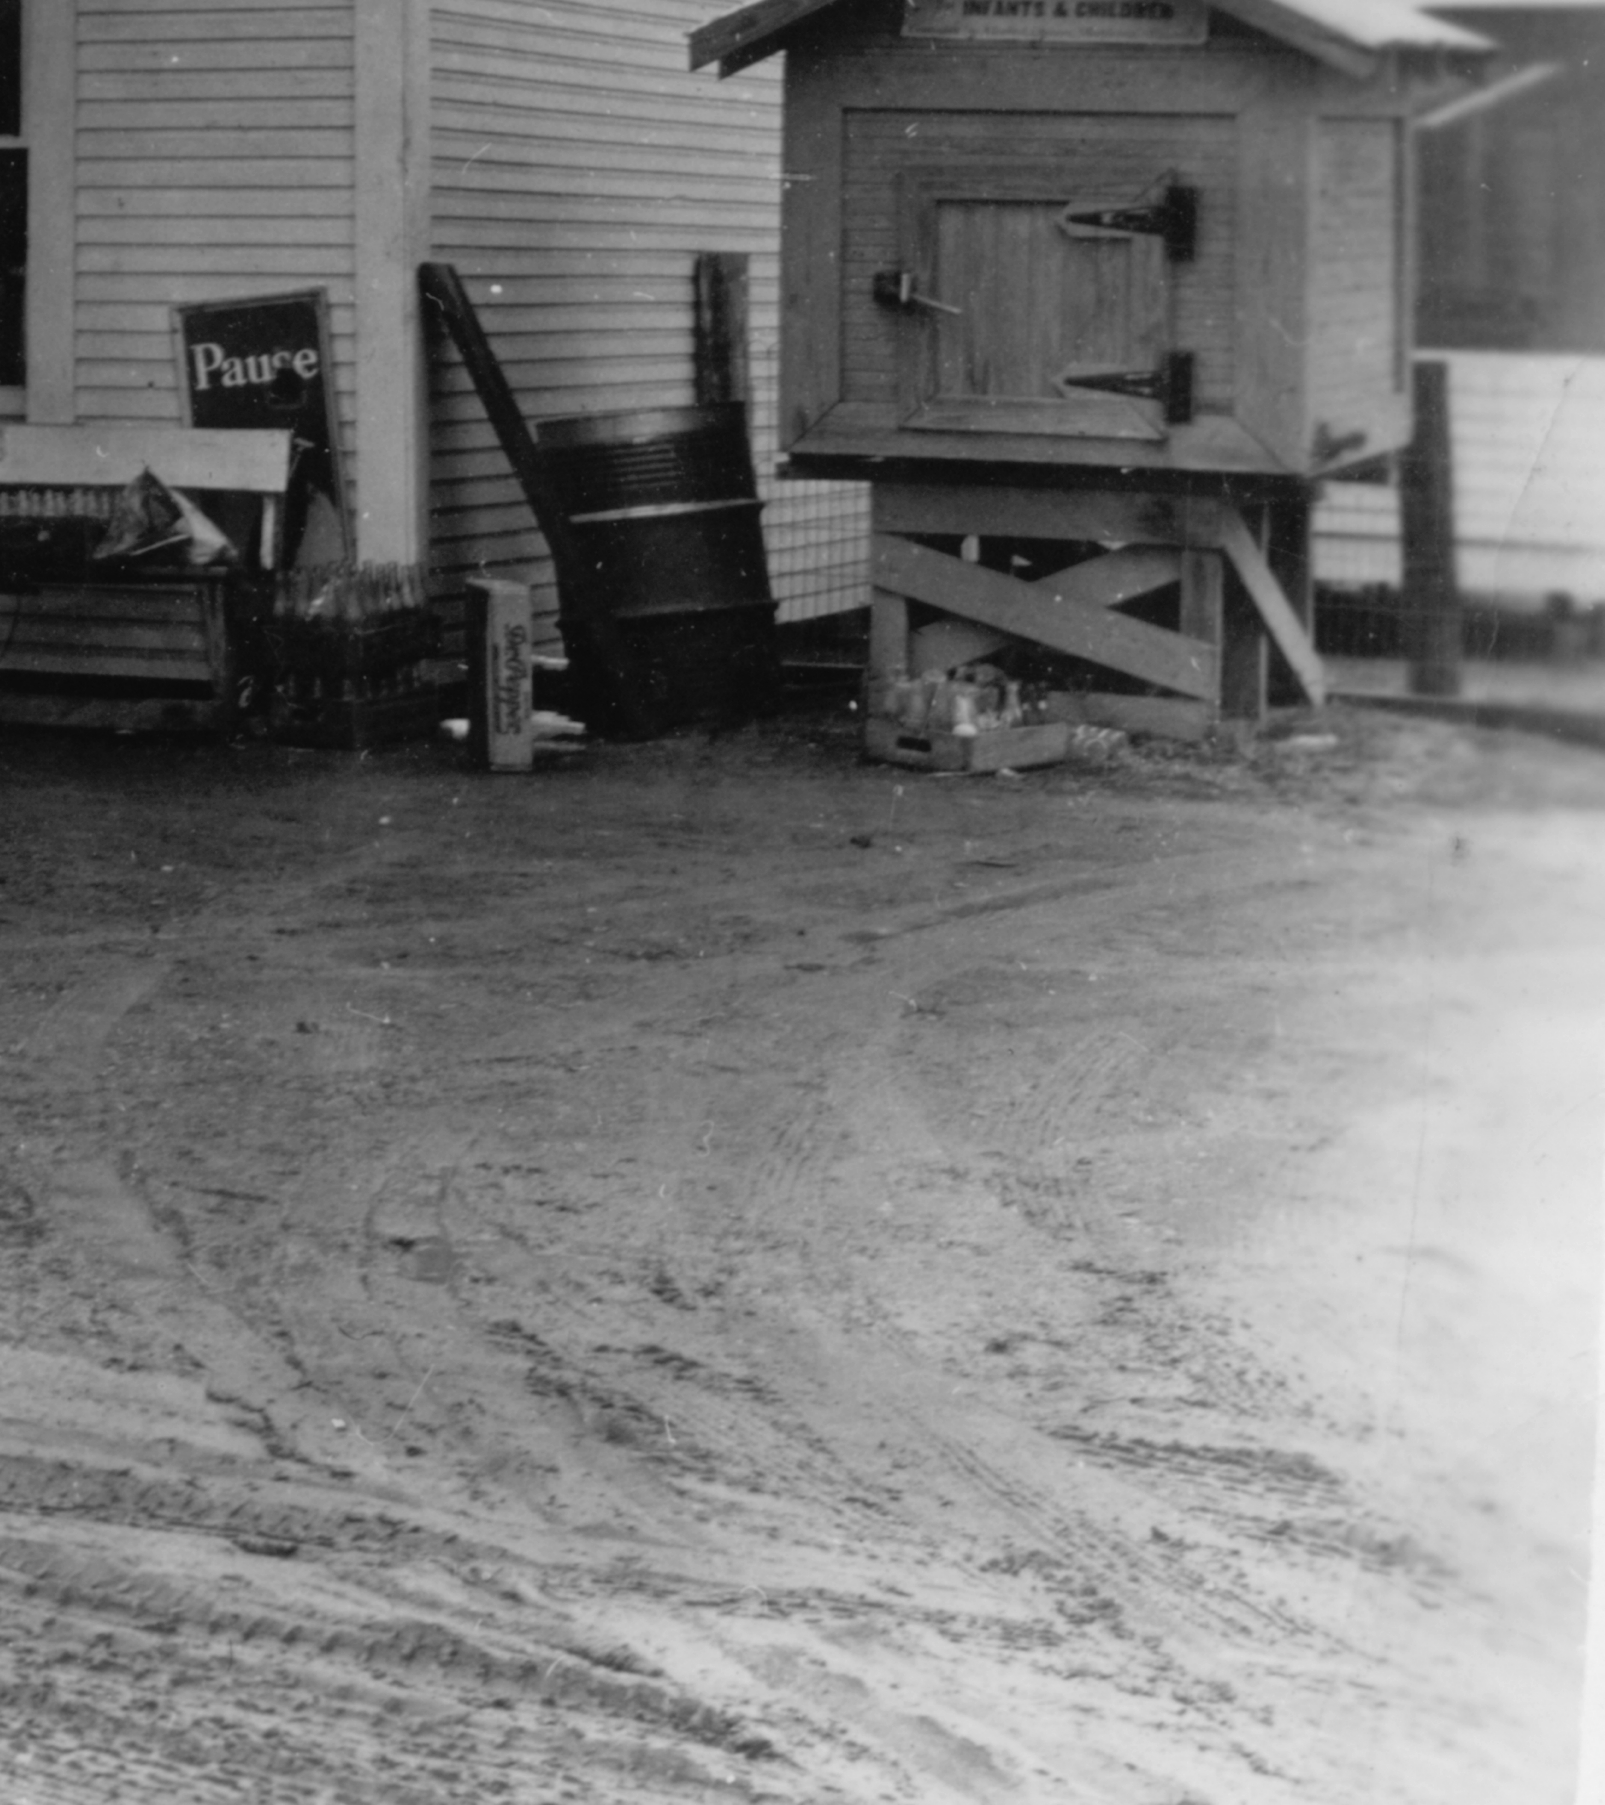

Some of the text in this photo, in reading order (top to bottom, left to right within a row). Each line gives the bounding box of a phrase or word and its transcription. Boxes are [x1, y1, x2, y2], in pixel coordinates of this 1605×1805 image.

[963, 0, 1045, 18] INFANTS
[1052, 0, 1068, 18] &
[1075, 0, 1174, 21] CHILDREN
